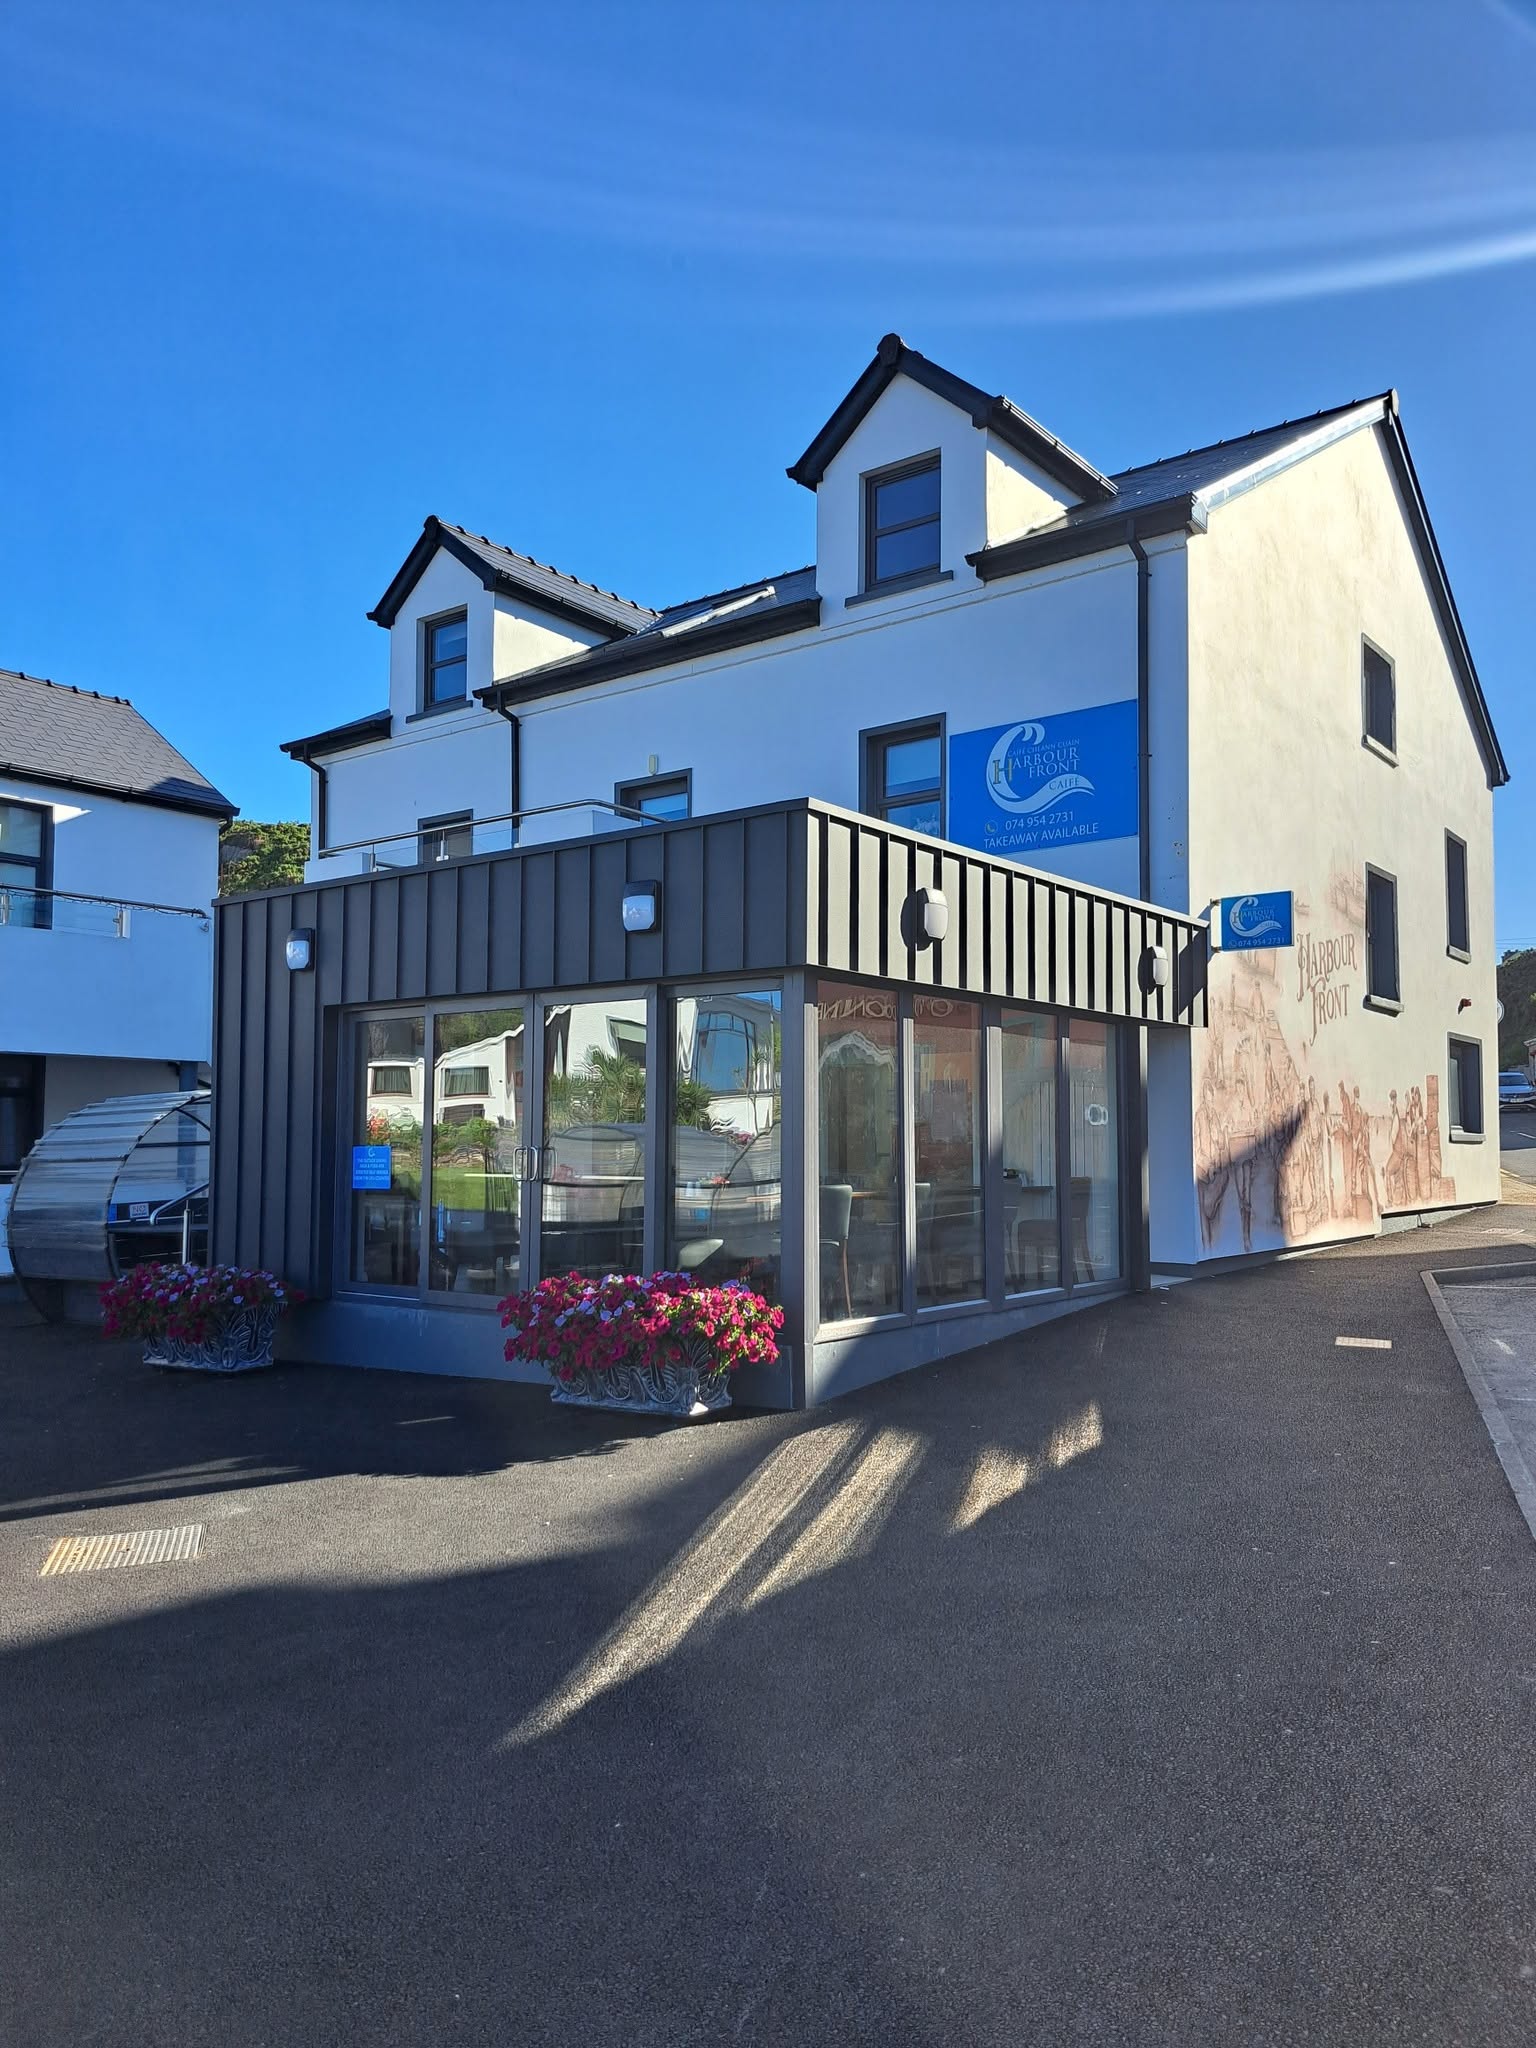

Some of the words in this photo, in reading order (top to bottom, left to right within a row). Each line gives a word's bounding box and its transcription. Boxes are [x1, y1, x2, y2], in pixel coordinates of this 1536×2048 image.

[993, 747, 1079, 784] HARBOUR
[1029, 759, 1080, 778] FRONT
[1005, 819, 1024, 831] 074
[1027, 816, 1046, 827] 954
[1049, 811, 1073, 824] 2731
[984, 832, 1038, 849] TAKEAWAY
[1041, 823, 1099, 841] AVAILABLE
[1253, 938, 1266, 946] 954
[1266, 937, 1284, 945] 2731
[1296, 932, 1357, 1002] HARBOUR
[1309, 977, 1349, 1047] FRONT
